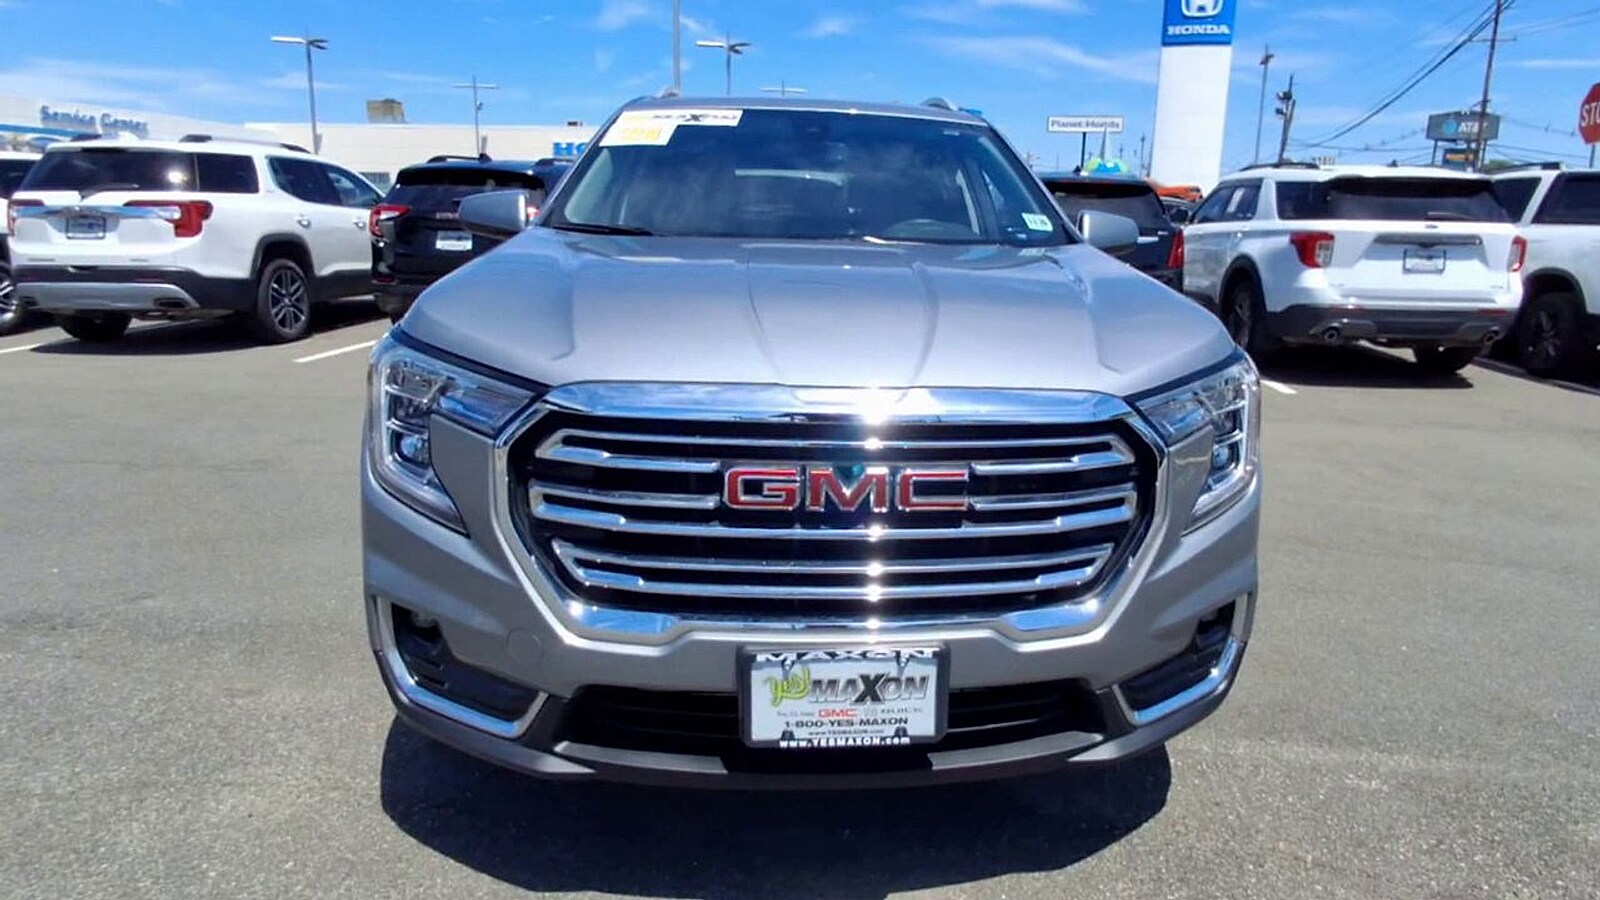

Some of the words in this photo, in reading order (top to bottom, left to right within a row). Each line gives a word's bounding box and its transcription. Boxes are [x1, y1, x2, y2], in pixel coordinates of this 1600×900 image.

[1167, 24, 1231, 35] HONDA
[41, 104, 96, 124] Service
[101, 112, 149, 131] Center
[1051, 119, 1082, 129] Planet
[1086, 119, 1120, 129] Honda
[725, 466, 969, 512] GMC
[809, 673, 930, 704] MAXON
[818, 708, 858, 718] GMC
